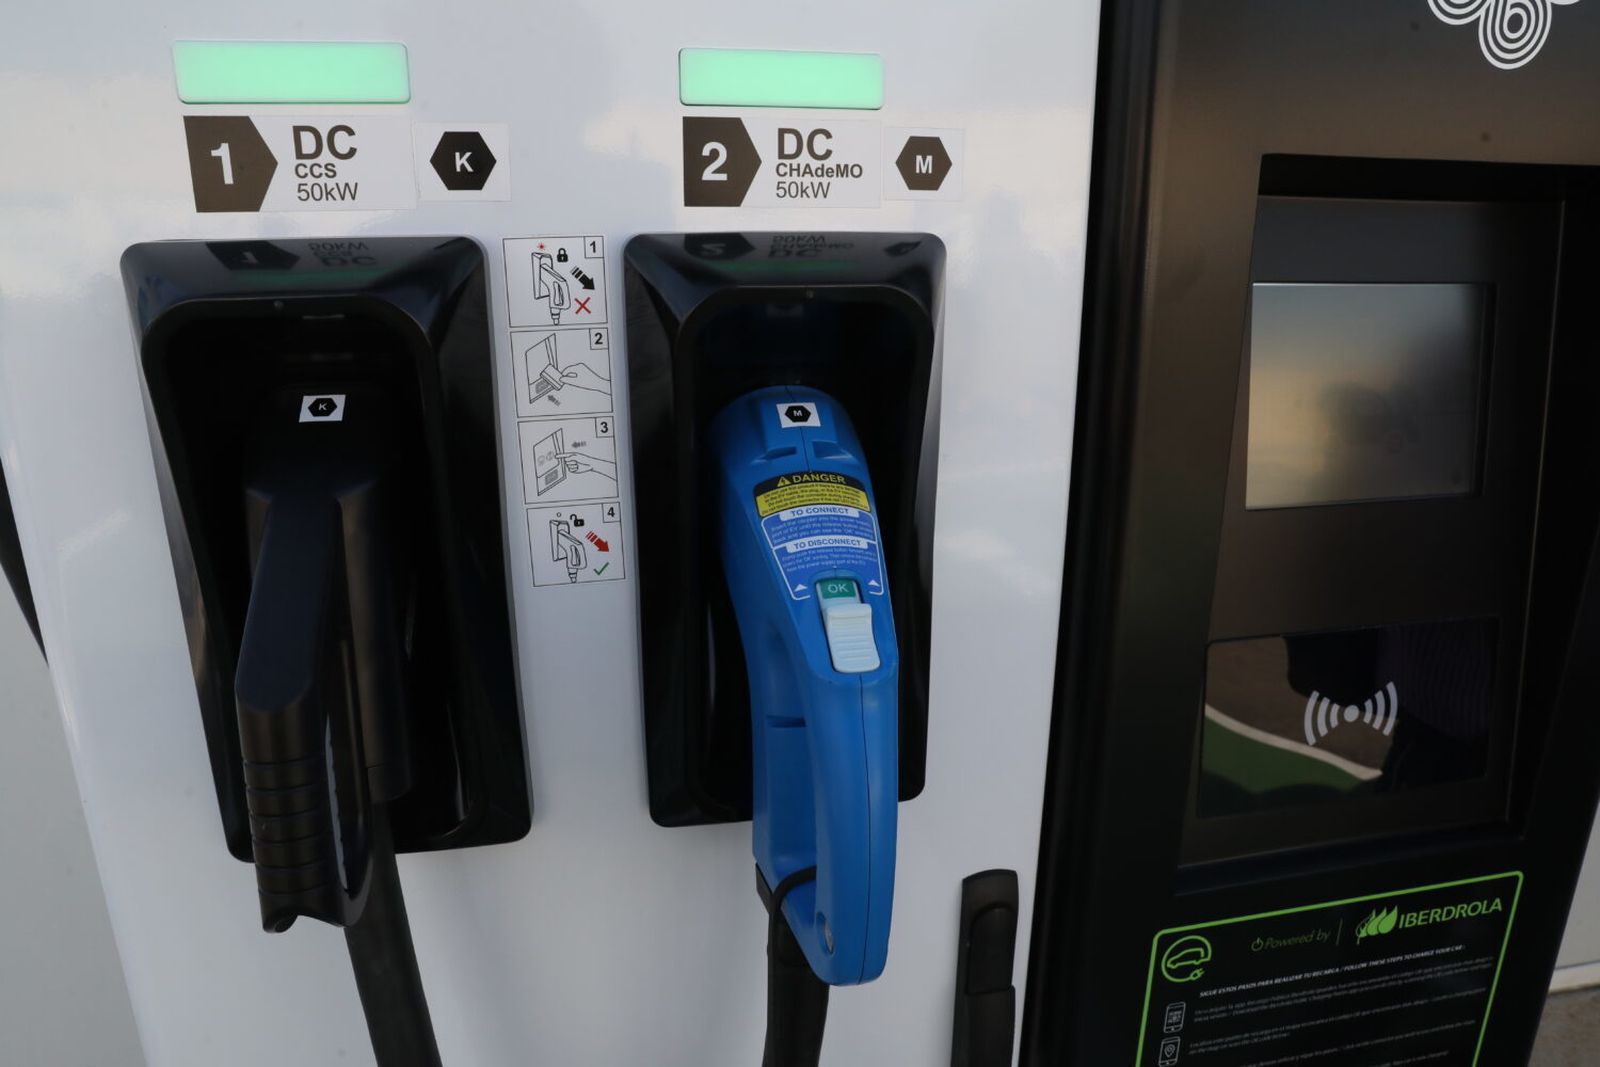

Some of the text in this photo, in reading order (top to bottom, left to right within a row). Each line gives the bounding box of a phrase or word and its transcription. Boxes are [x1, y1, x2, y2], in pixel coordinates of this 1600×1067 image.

[292, 124, 358, 161] DC
[777, 127, 833, 161] DC
[211, 142, 234, 185] 1
[454, 151, 475, 173] K
[701, 141, 728, 181] 2
[915, 155, 933, 174] M
[294, 162, 338, 179] CCS
[775, 162, 863, 179] CHAdeMO
[297, 181, 359, 201] 50kW
[775, 180, 831, 199] 50kW
[590, 241, 597, 253] 1
[594, 332, 603, 345] 2
[318, 402, 328, 411] K
[793, 409, 803, 417] M
[600, 421, 609, 434] 3
[792, 474, 847, 485] DANGER
[607, 506, 616, 518] 4
[791, 506, 849, 517] TO CONNECT
[793, 538, 862, 550] TO DISCONNECT
[827, 583, 849, 594] OK
[1399, 897, 1503, 929] IBERDROLA
[1264, 928, 1331, 949] Powered by
